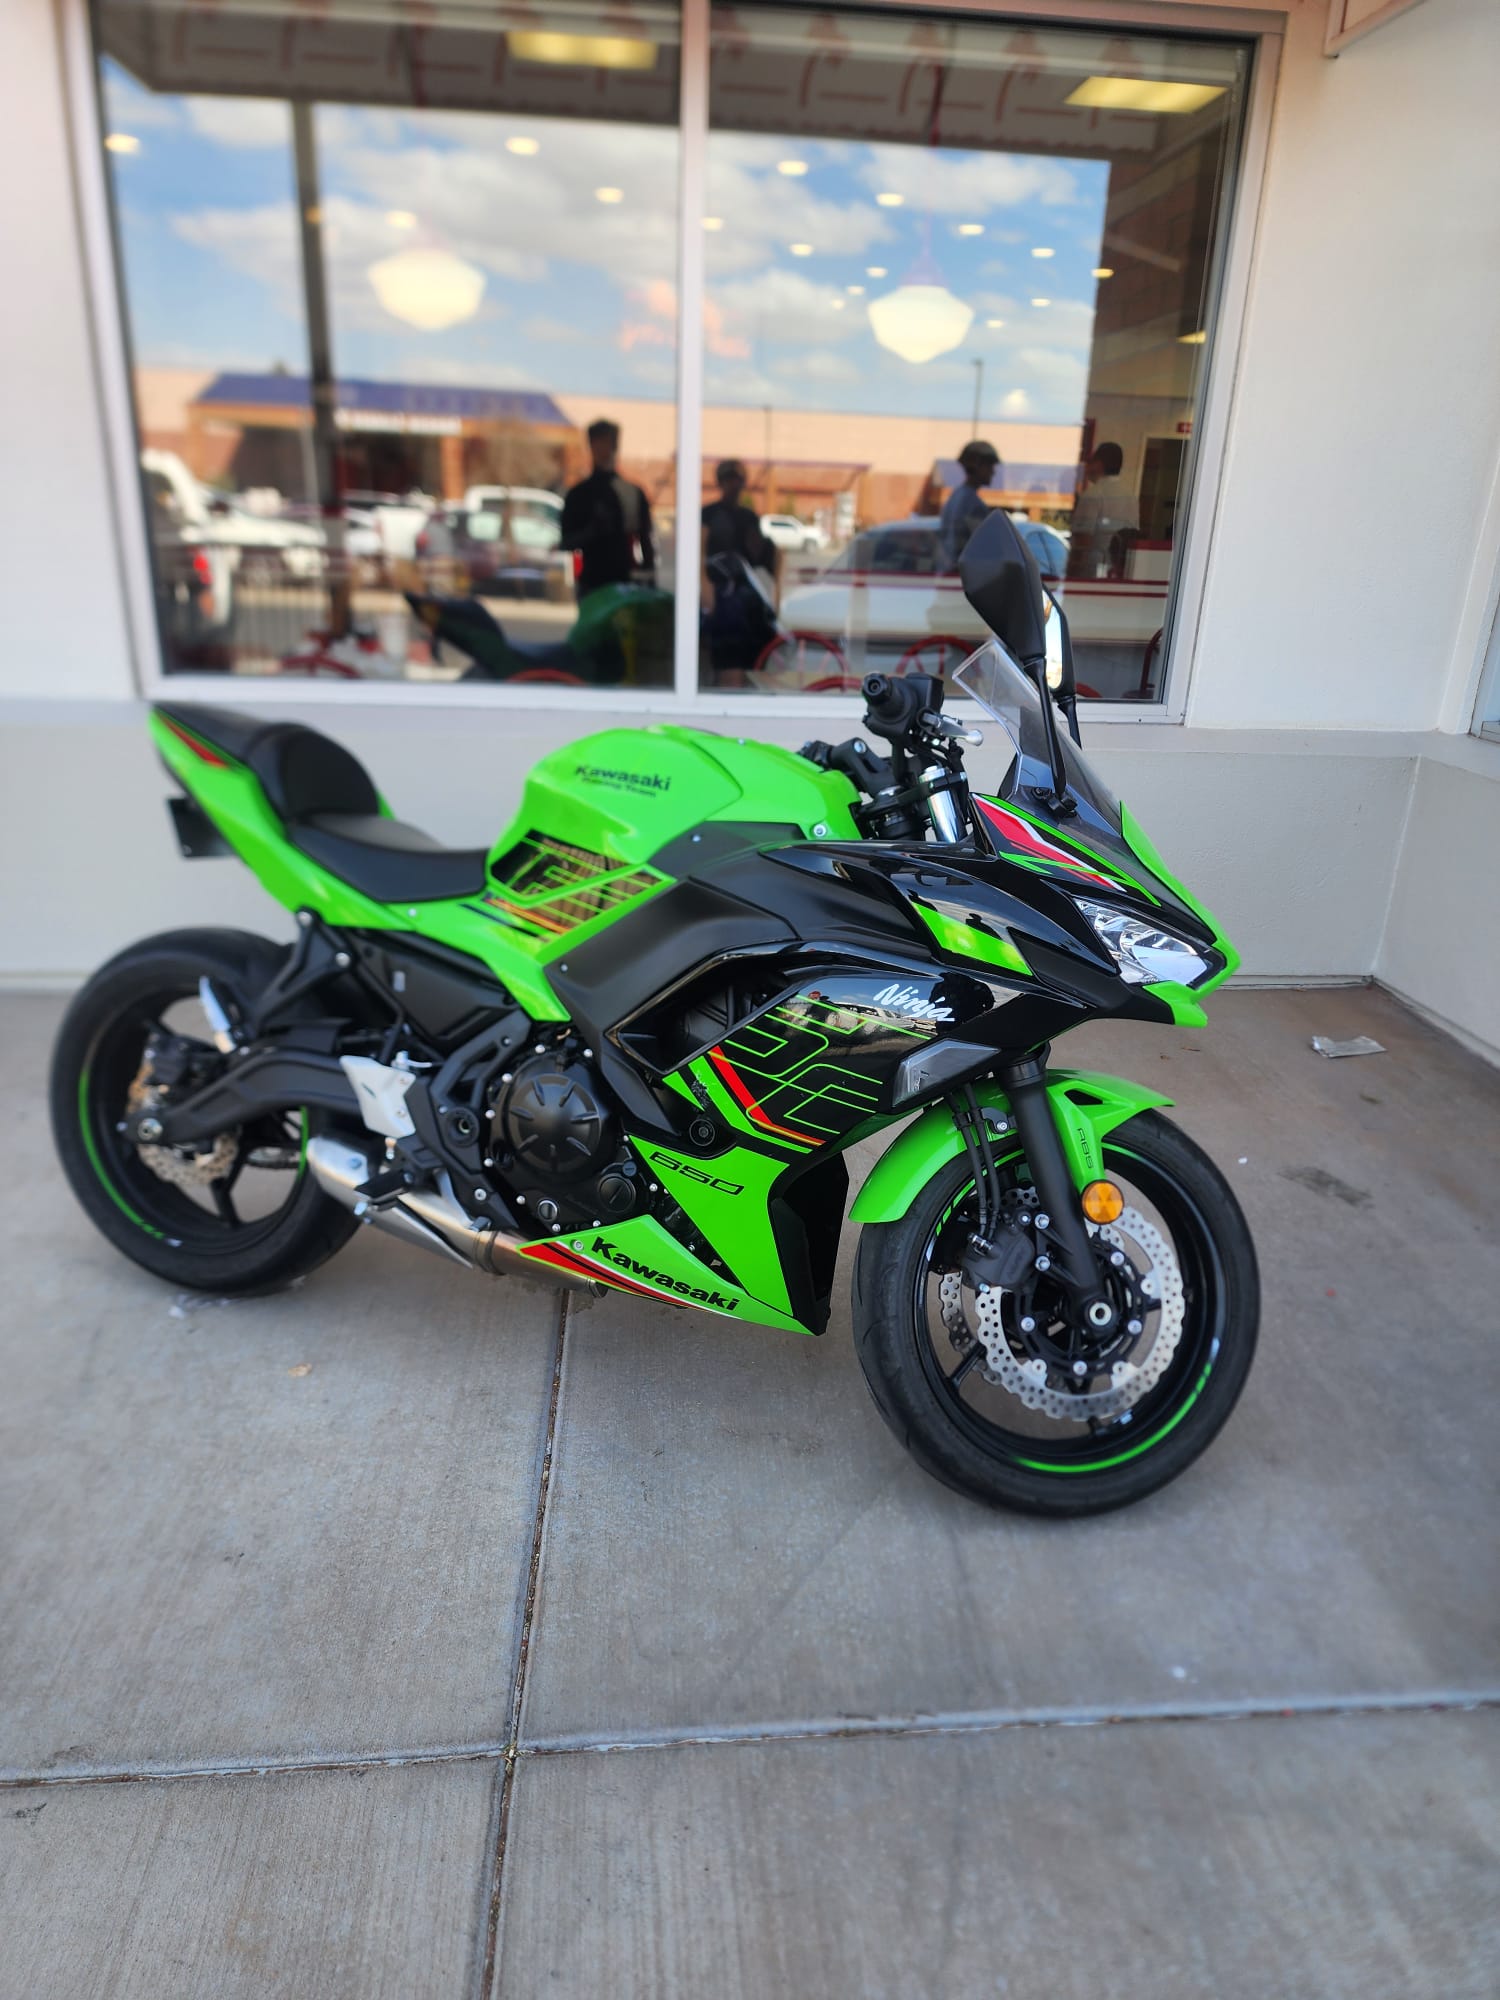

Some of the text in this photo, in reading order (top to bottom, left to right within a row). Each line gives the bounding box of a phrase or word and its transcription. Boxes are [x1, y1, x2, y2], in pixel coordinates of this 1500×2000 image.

[574, 766, 671, 791] Kawasaki
[873, 983, 955, 1021] Ninja
[1076, 1127, 1094, 1169] ABS
[649, 1151, 745, 1196] 650
[591, 1236, 740, 1311] Kawasaki
